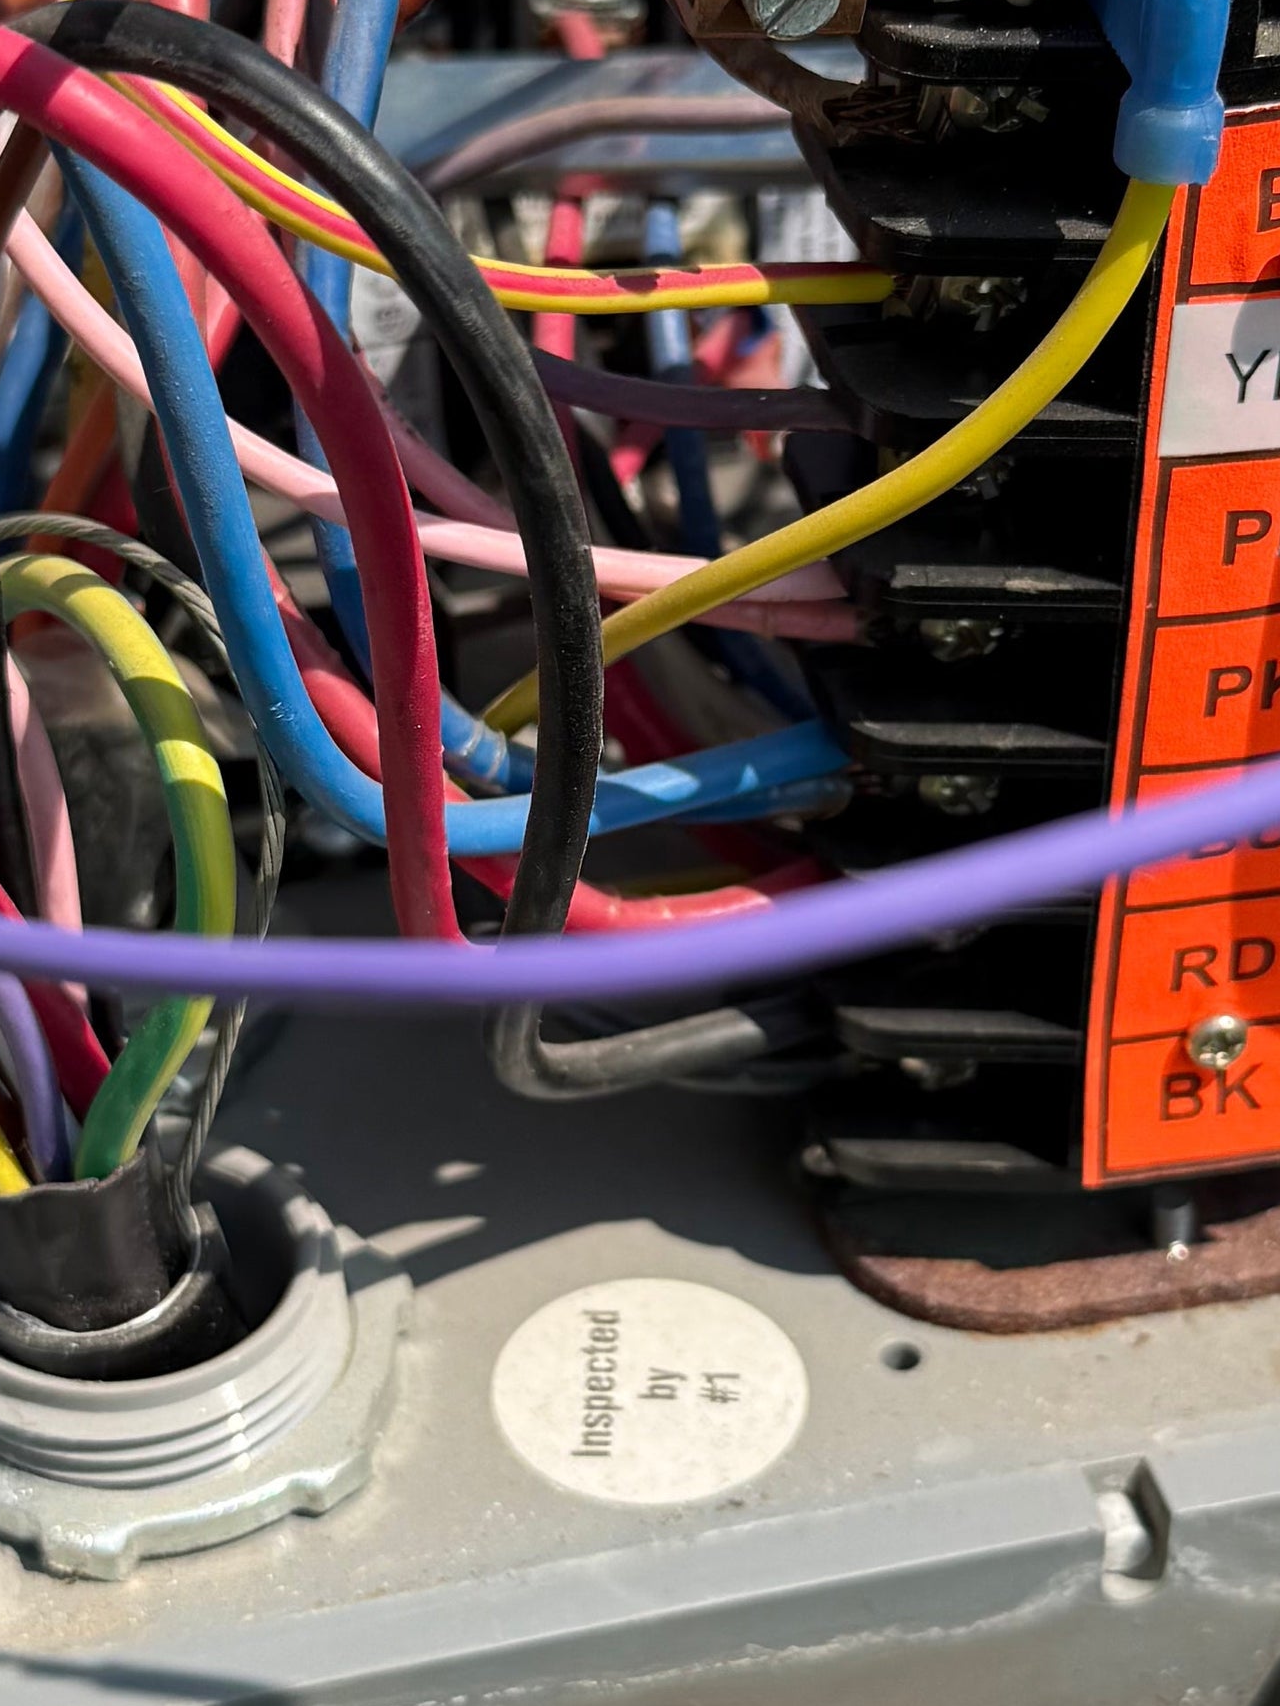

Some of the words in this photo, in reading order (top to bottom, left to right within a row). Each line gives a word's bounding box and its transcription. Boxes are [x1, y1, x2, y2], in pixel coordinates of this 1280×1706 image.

[1168, 936, 1277, 993] RD
[1158, 1062, 1264, 1122] BK
[570, 1308, 624, 1458] Inspected
[637, 1366, 688, 1401] by
[695, 1370, 742, 1405] #1
